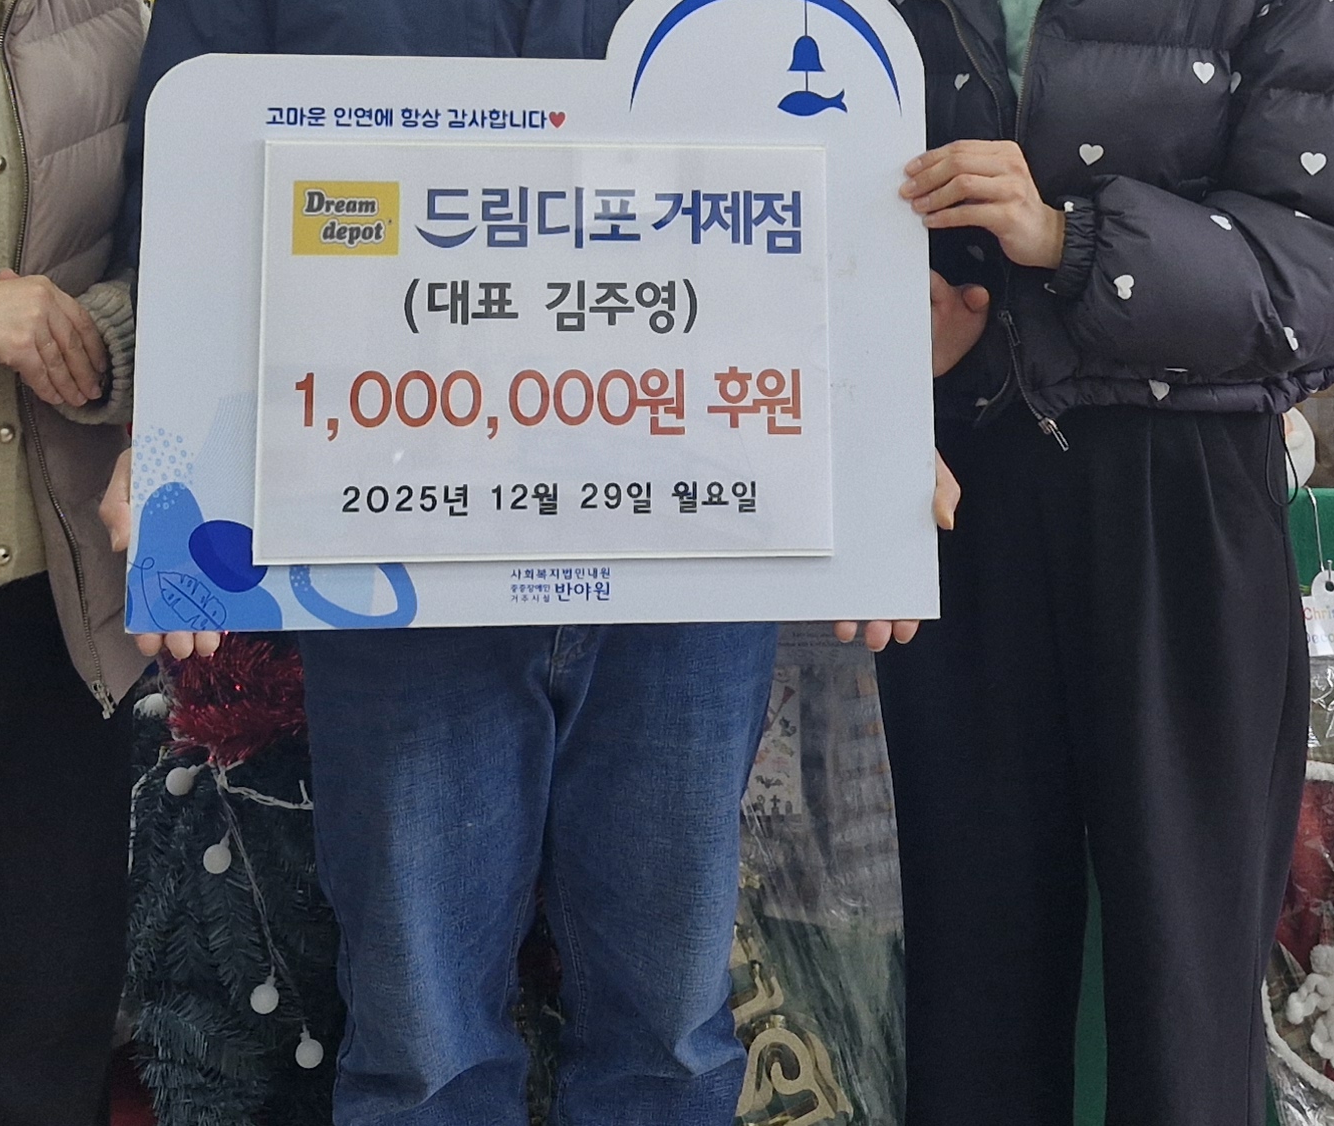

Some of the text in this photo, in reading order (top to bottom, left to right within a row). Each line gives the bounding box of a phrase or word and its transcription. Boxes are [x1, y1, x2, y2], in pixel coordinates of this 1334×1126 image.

[266, 106, 548, 130] 고마운 인연에 항상 감사합니다
[303, 189, 378, 216] Dream
[321, 219, 385, 246] depot
[414, 185, 803, 255] 드림디포 거제점
[403, 277, 699, 334] (대표 김주영)
[294, 366, 803, 441] 1,000,000원 후원
[341, 480, 758, 517] 2025년 12월 29일 월요일
[554, 580, 611, 603] 반야원
